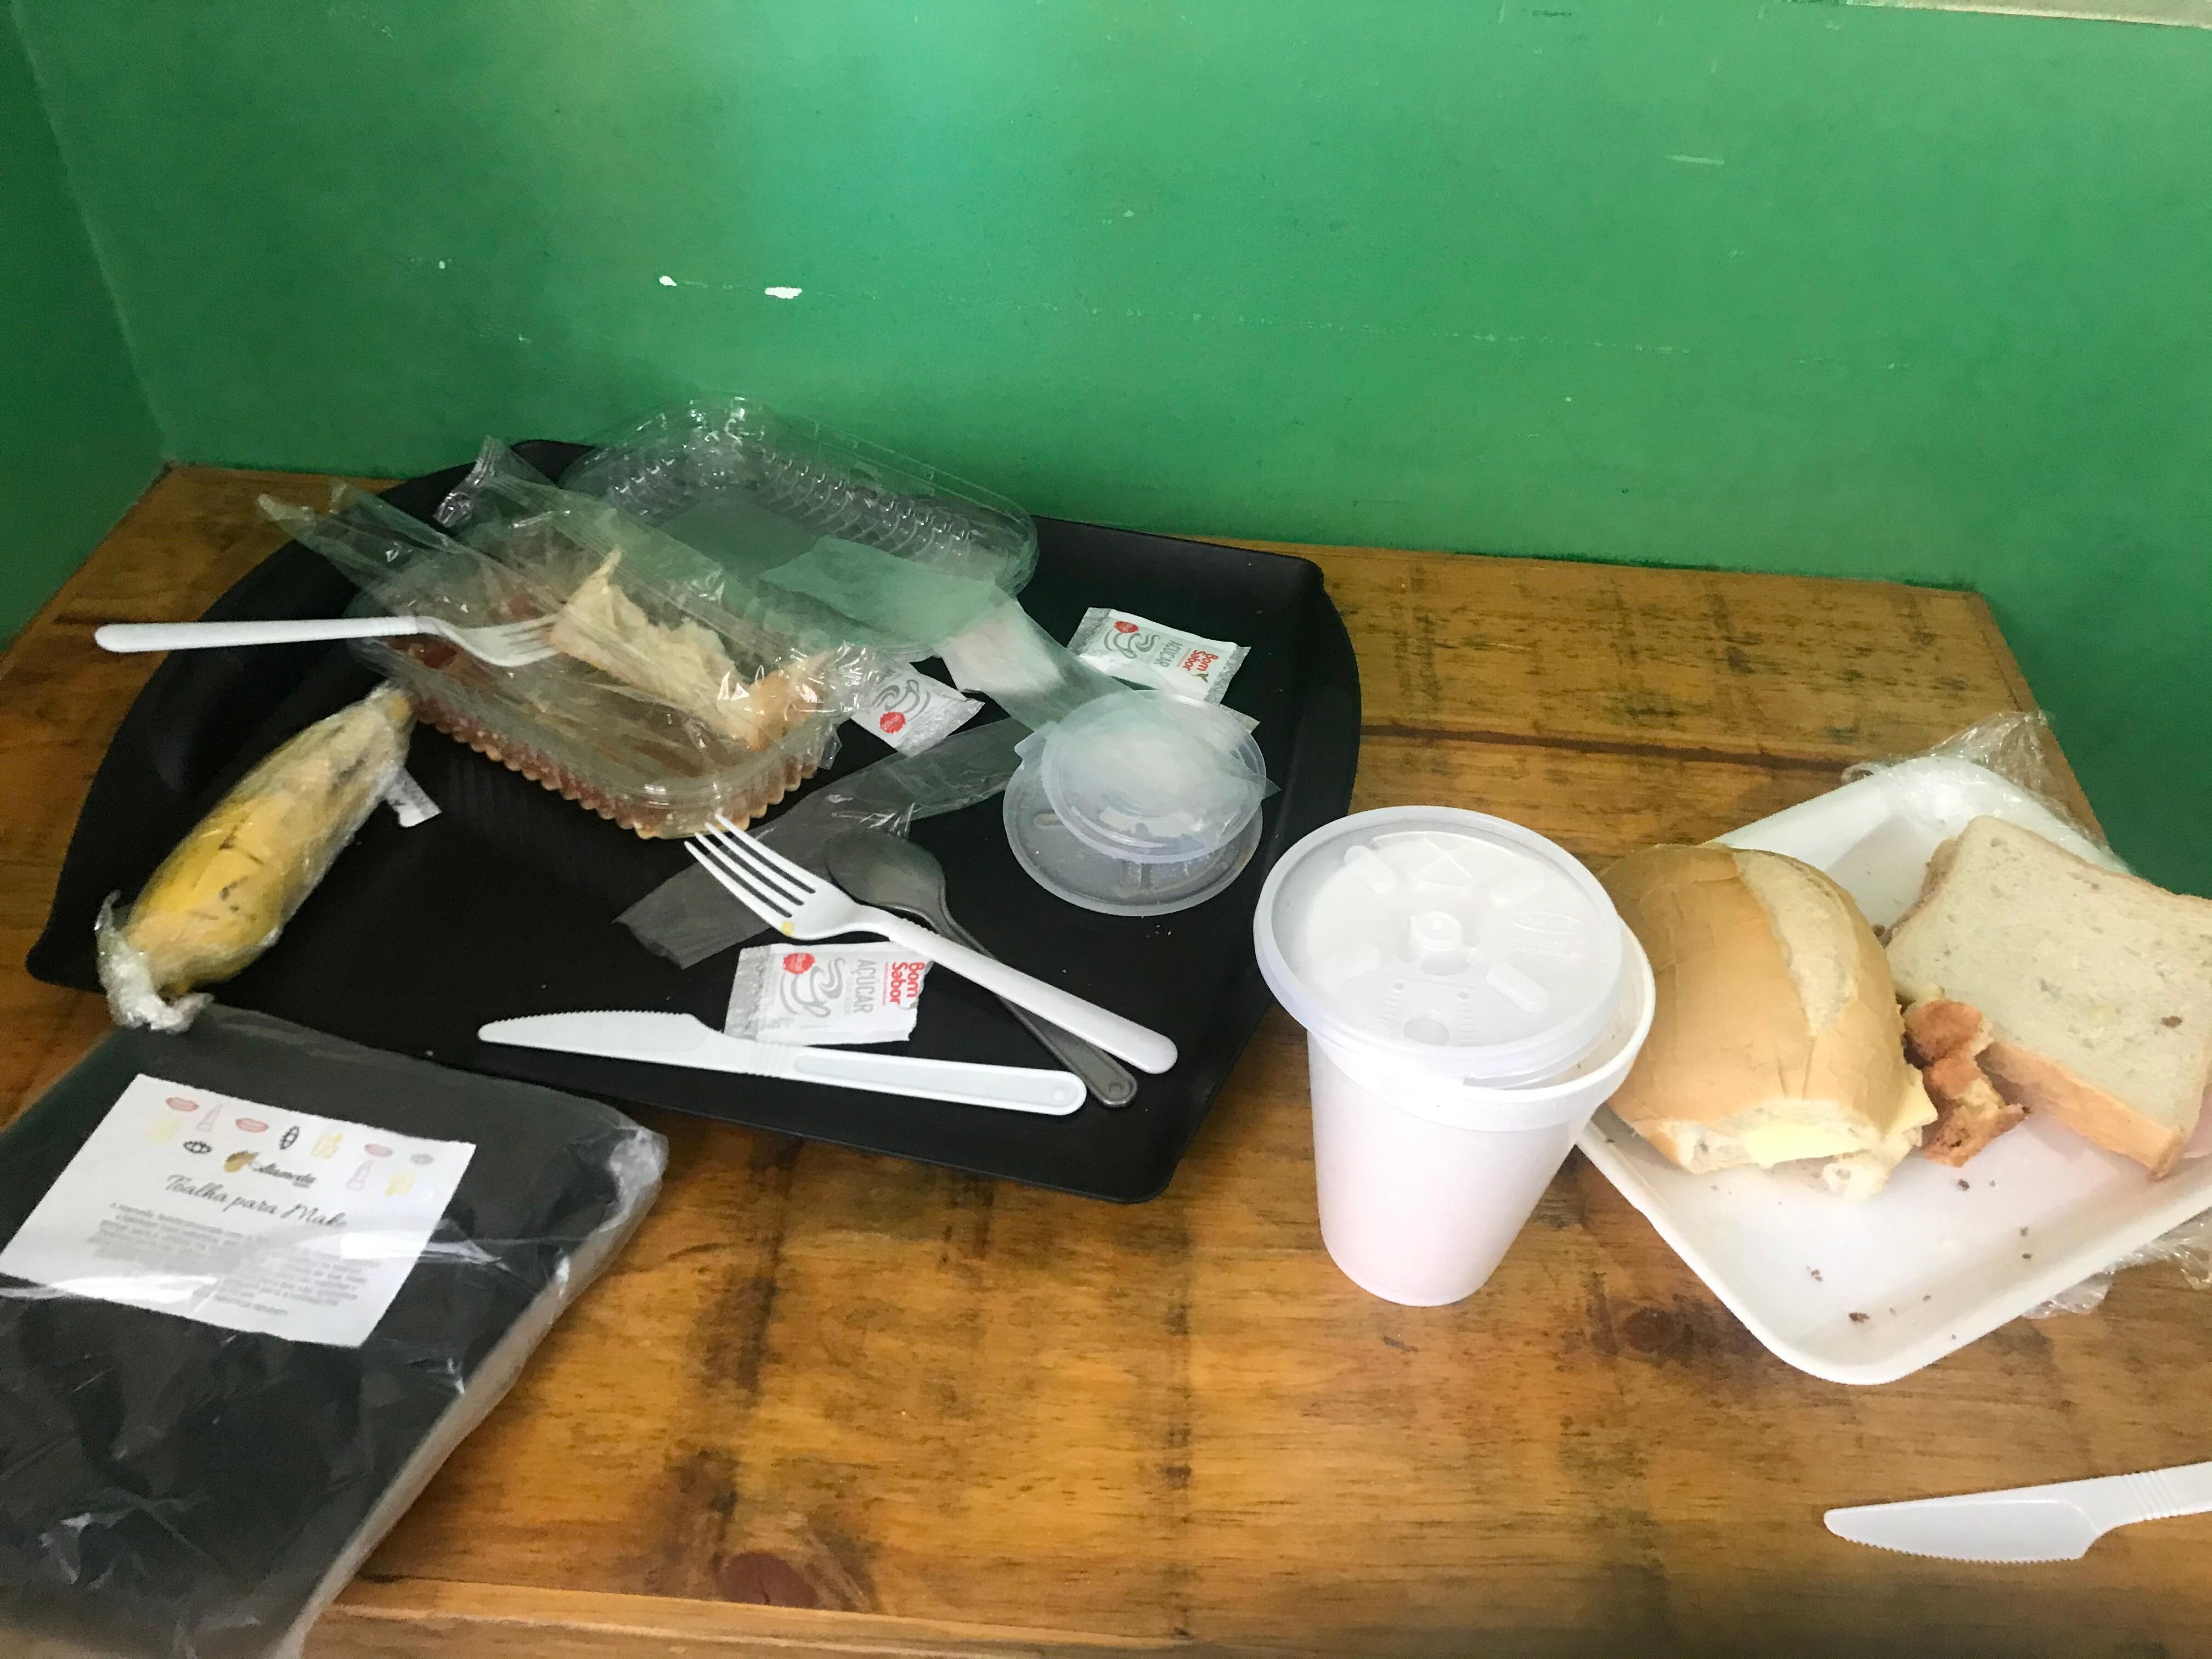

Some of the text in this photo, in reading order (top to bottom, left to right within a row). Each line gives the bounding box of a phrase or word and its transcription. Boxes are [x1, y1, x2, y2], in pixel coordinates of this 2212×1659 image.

[1183, 650, 1206, 671] Sabor
[1197, 653, 1219, 672] Bom
[889, 962, 909, 1005] Sabor
[906, 962, 925, 998] Bom
[165, 1174, 228, 1203] Toalha
[222, 1197, 277, 1214] para
